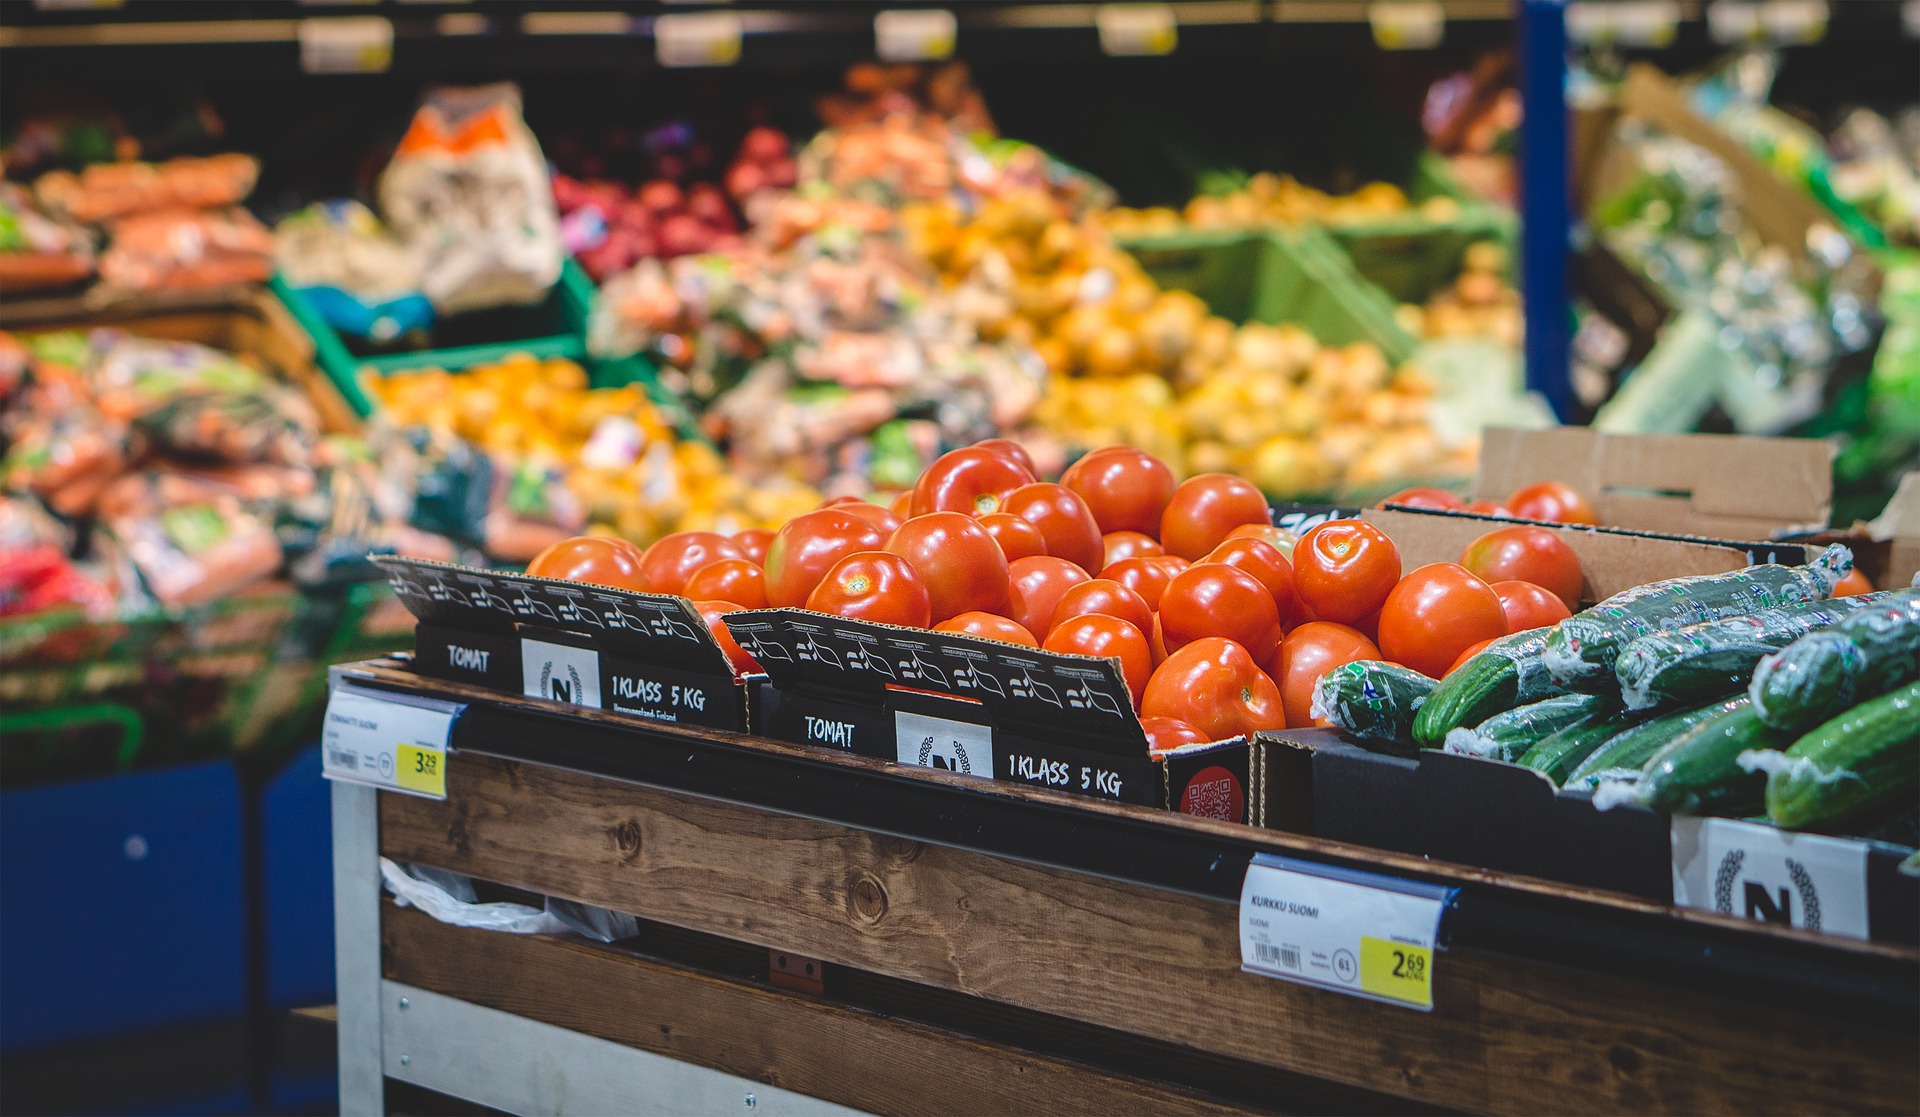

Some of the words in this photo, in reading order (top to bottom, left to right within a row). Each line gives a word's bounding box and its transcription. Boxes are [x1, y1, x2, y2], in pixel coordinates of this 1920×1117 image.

[447, 645, 490, 673] TOMAT
[552, 677, 571, 703] N
[612, 675, 618, 696] 1
[619, 676, 662, 703] KLASS
[671, 685, 680, 706] 5
[683, 687, 706, 712] KG
[804, 715, 855, 748] TOMAT
[1009, 754, 1015, 776] 1
[1018, 754, 1070, 785] KLASS
[1080, 766, 1091, 790] 5
[1095, 769, 1123, 797] KG
[1251, 894, 1287, 912] KURKKU
[1288, 902, 1319, 918] SUOMI
[1745, 882, 1791, 926] N
[1249, 917, 1269, 928] SUOMI
[1338, 957, 1350, 972] 61
